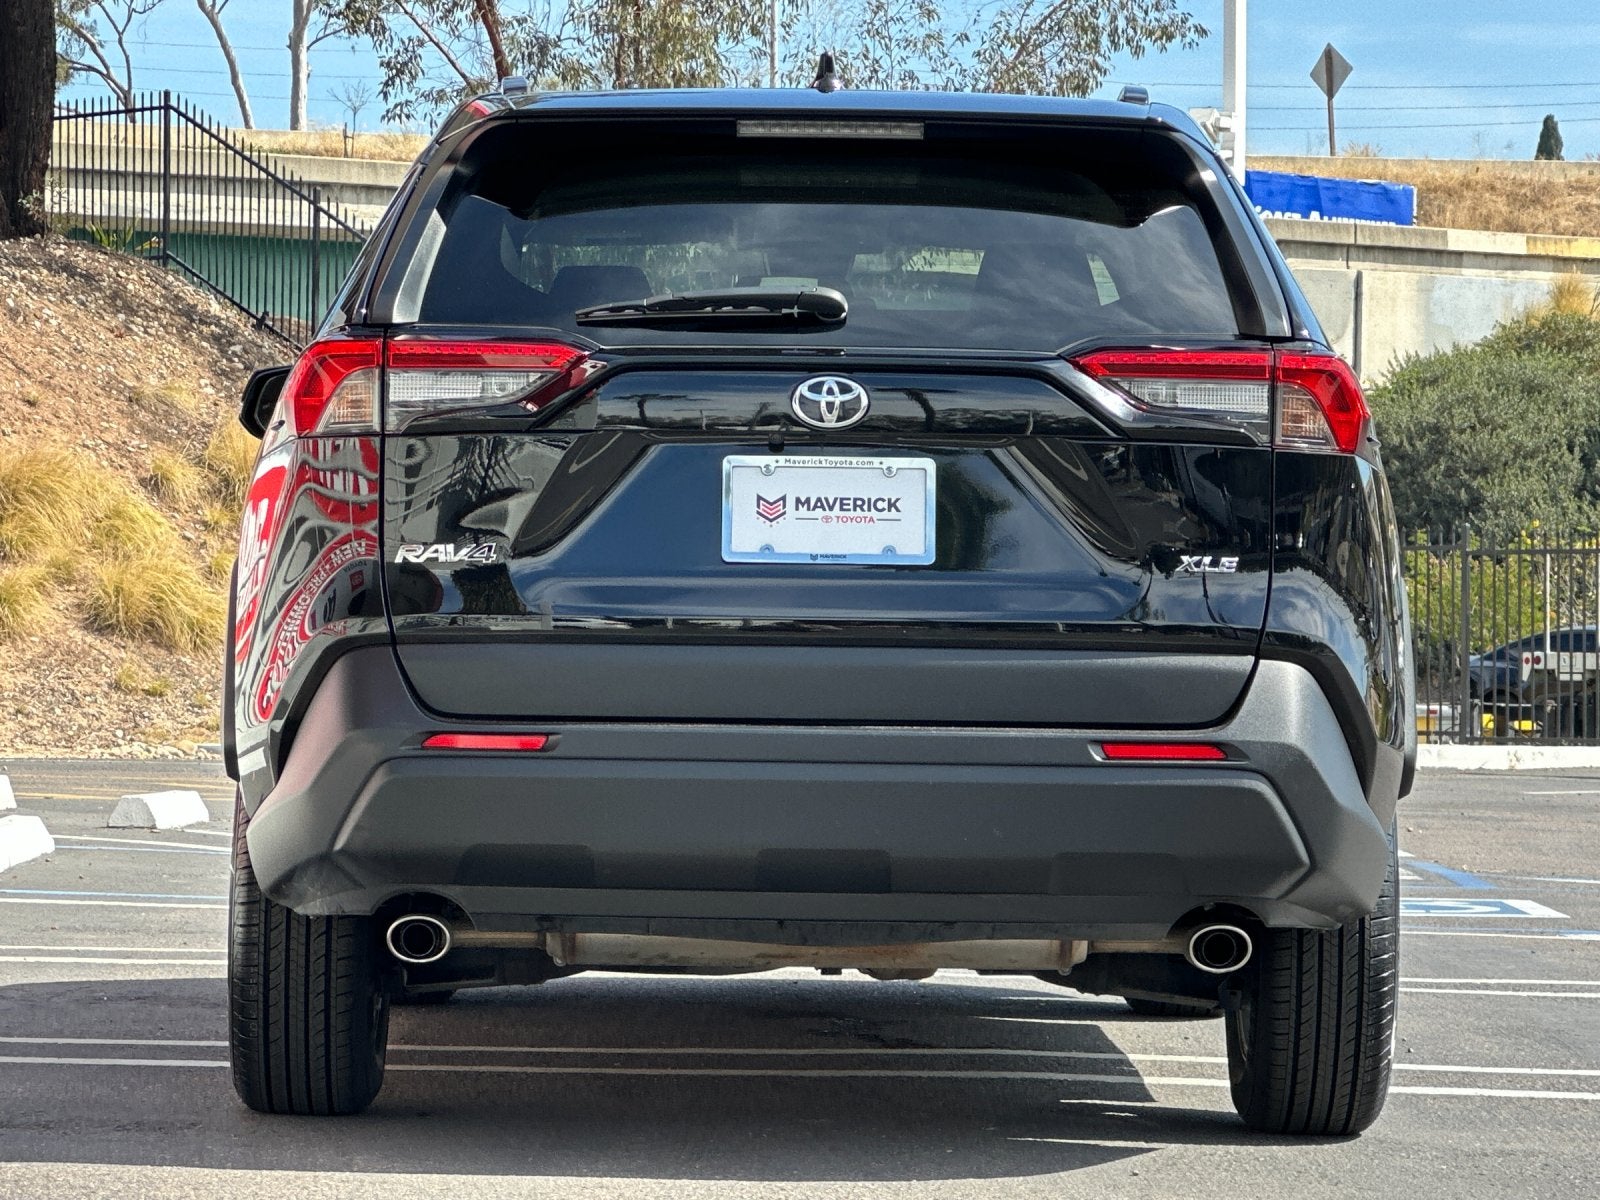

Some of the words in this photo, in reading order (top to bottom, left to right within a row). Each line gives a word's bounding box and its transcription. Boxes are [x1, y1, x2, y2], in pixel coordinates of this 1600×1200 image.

[784, 458, 874, 467] MaverickToyota.com
[795, 496, 902, 513] MAVERICK
[835, 515, 875, 524] TOYOTA
[395, 542, 497, 563] RAV4
[1175, 555, 1239, 573] XLE
